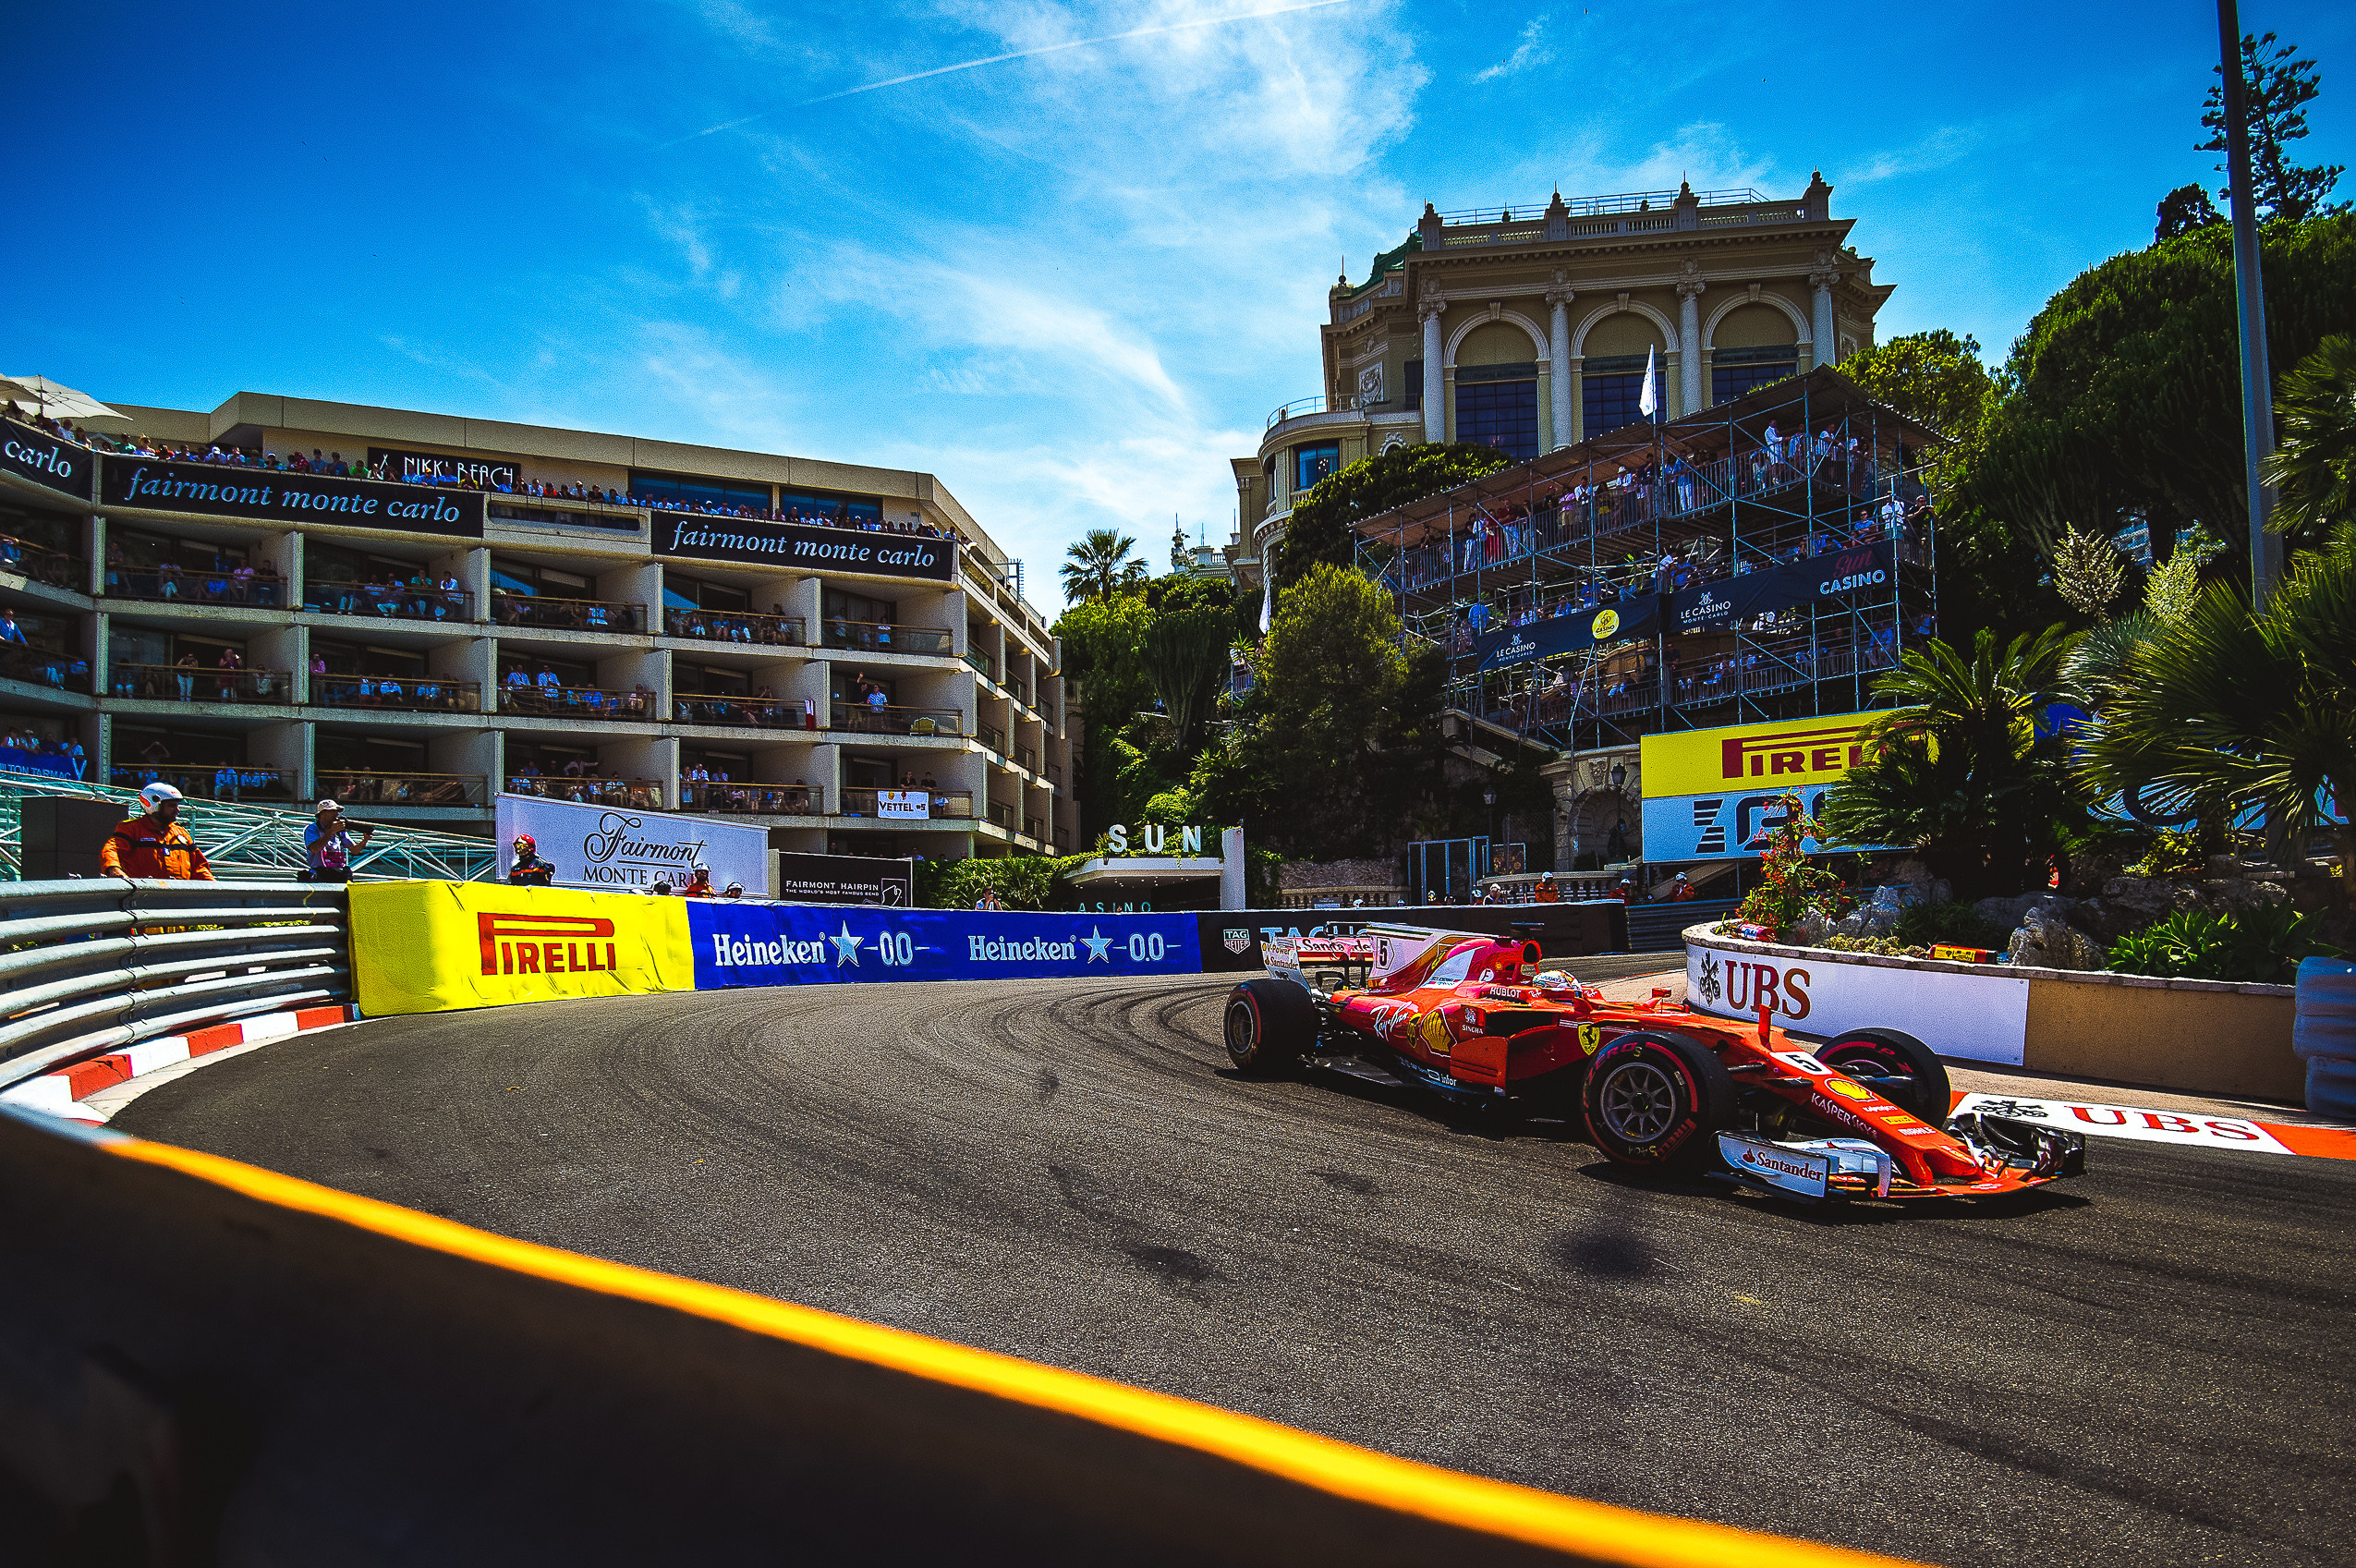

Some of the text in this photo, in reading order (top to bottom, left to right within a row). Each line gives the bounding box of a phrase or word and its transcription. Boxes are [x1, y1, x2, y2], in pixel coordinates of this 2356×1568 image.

[5, 440, 72, 478] carlo
[124, 467, 460, 523] fairmont monte carlo
[670, 520, 935, 567] fairmont monte carlo
[1833, 551, 1873, 578] Sun
[1819, 569, 1886, 595] CASINO
[1681, 601, 1731, 619] LE CASINO
[1496, 641, 1536, 658] LE CASINO
[879, 800, 914, 812] VETTEL
[583, 811, 708, 869] Fairmont
[1108, 823, 1201, 853] SUN
[582, 864, 696, 888] MONTE CARL
[785, 880, 880, 892] FAIRMONT HAIRPIN
[1061, 902, 1151, 913] ASINO
[478, 912, 617, 976] PIRELLI
[1225, 930, 1247, 939] TAG
[1225, 939, 1250, 954] HEUER
[712, 932, 827, 966] Heineken
[967, 935, 1077, 961] Heineken
[1378, 940, 1388, 967] 5
[1270, 956, 1299, 971] Santander
[1489, 986, 1523, 999] HUBLOT
[1724, 959, 1811, 1021] UBS
[1462, 1024, 1484, 1035] SINGHA
[1785, 1054, 1823, 1072] 5
[1441, 1074, 1457, 1087] infor
[1811, 1092, 1872, 1136] KASPERSKY
[2063, 1105, 2260, 1140] UBS
[1756, 1150, 1824, 1182] Santander
